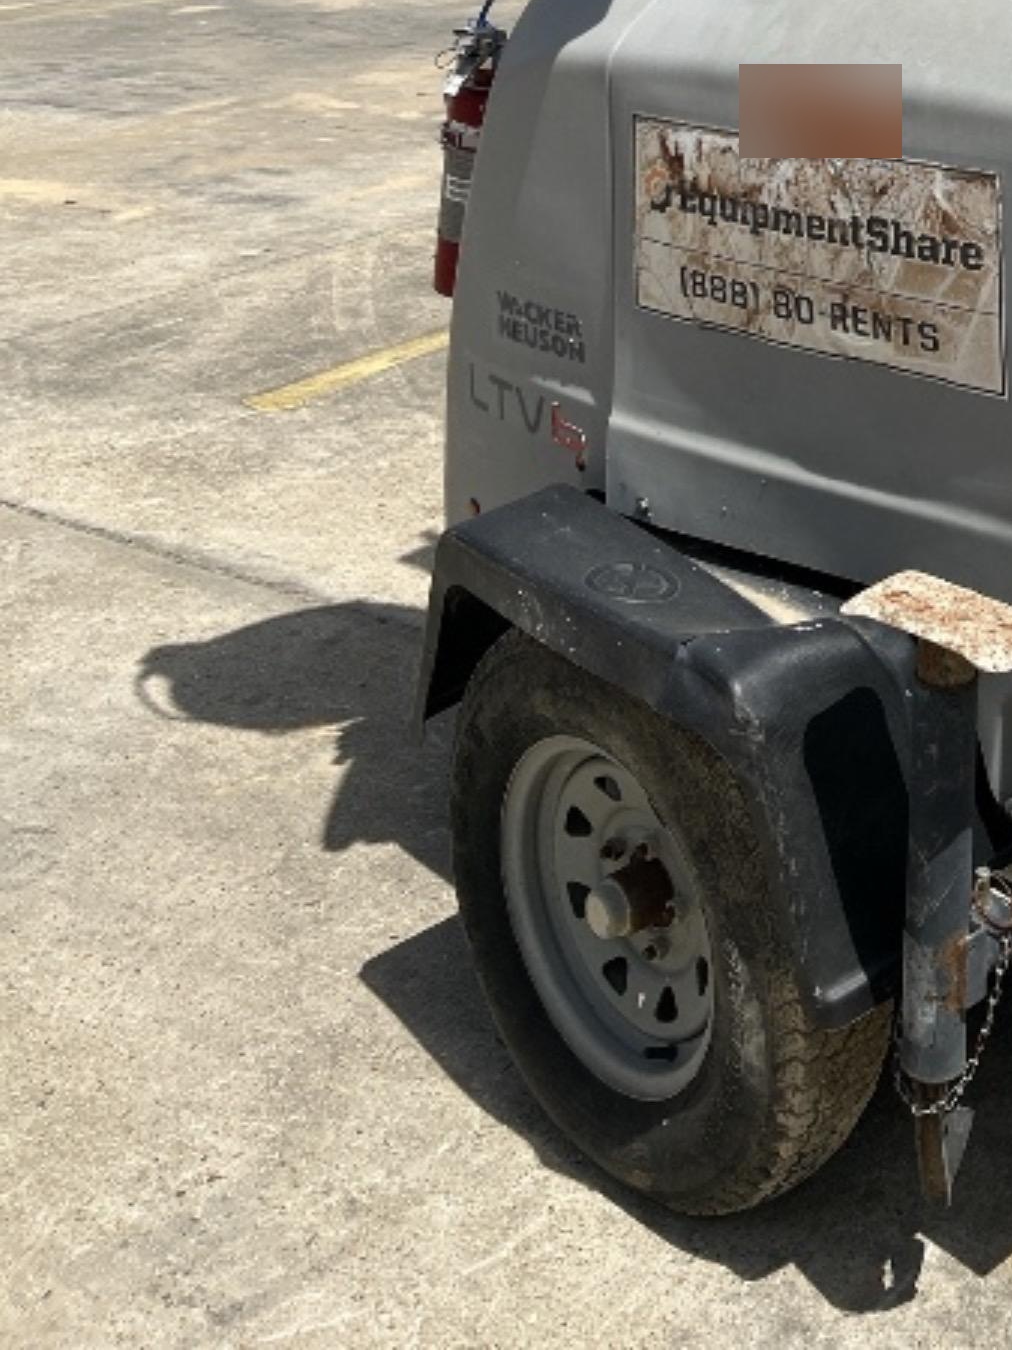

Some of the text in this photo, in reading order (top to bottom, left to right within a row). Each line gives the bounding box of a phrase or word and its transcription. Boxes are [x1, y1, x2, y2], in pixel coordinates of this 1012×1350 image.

[679, 265, 761, 311] (888)
[497, 290, 583, 338] WACKER
[498, 315, 585, 364] NEUSON
